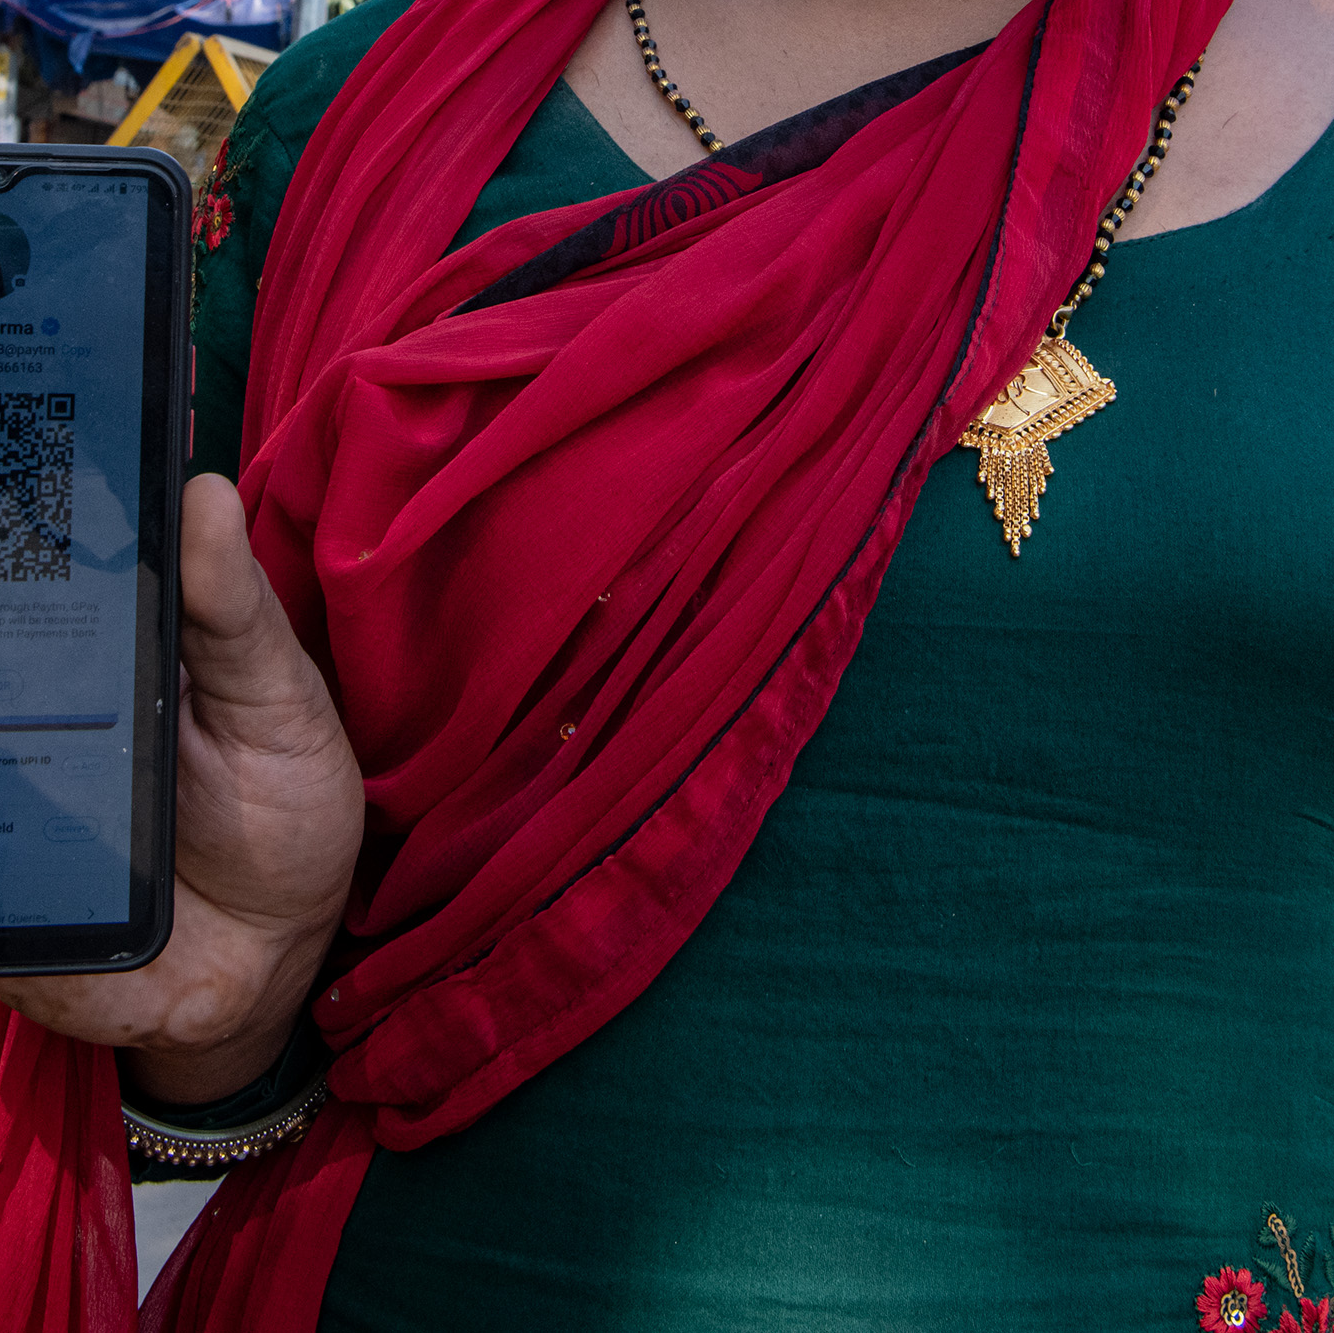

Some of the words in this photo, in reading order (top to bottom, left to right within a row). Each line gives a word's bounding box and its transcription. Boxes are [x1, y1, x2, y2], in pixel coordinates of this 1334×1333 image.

[61, 344, 92, 357] Copy
[32, 602, 68, 615] Paytm,
[8, 615, 26, 626] will
[28, 615, 41, 625] be
[44, 615, 88, 625] received
[90, 614, 99, 624] in
[16, 629, 68, 641] Payments
[71, 628, 97, 639] Bank
[20, 756, 38, 765] UPI
[40, 755, 51, 765] ID
